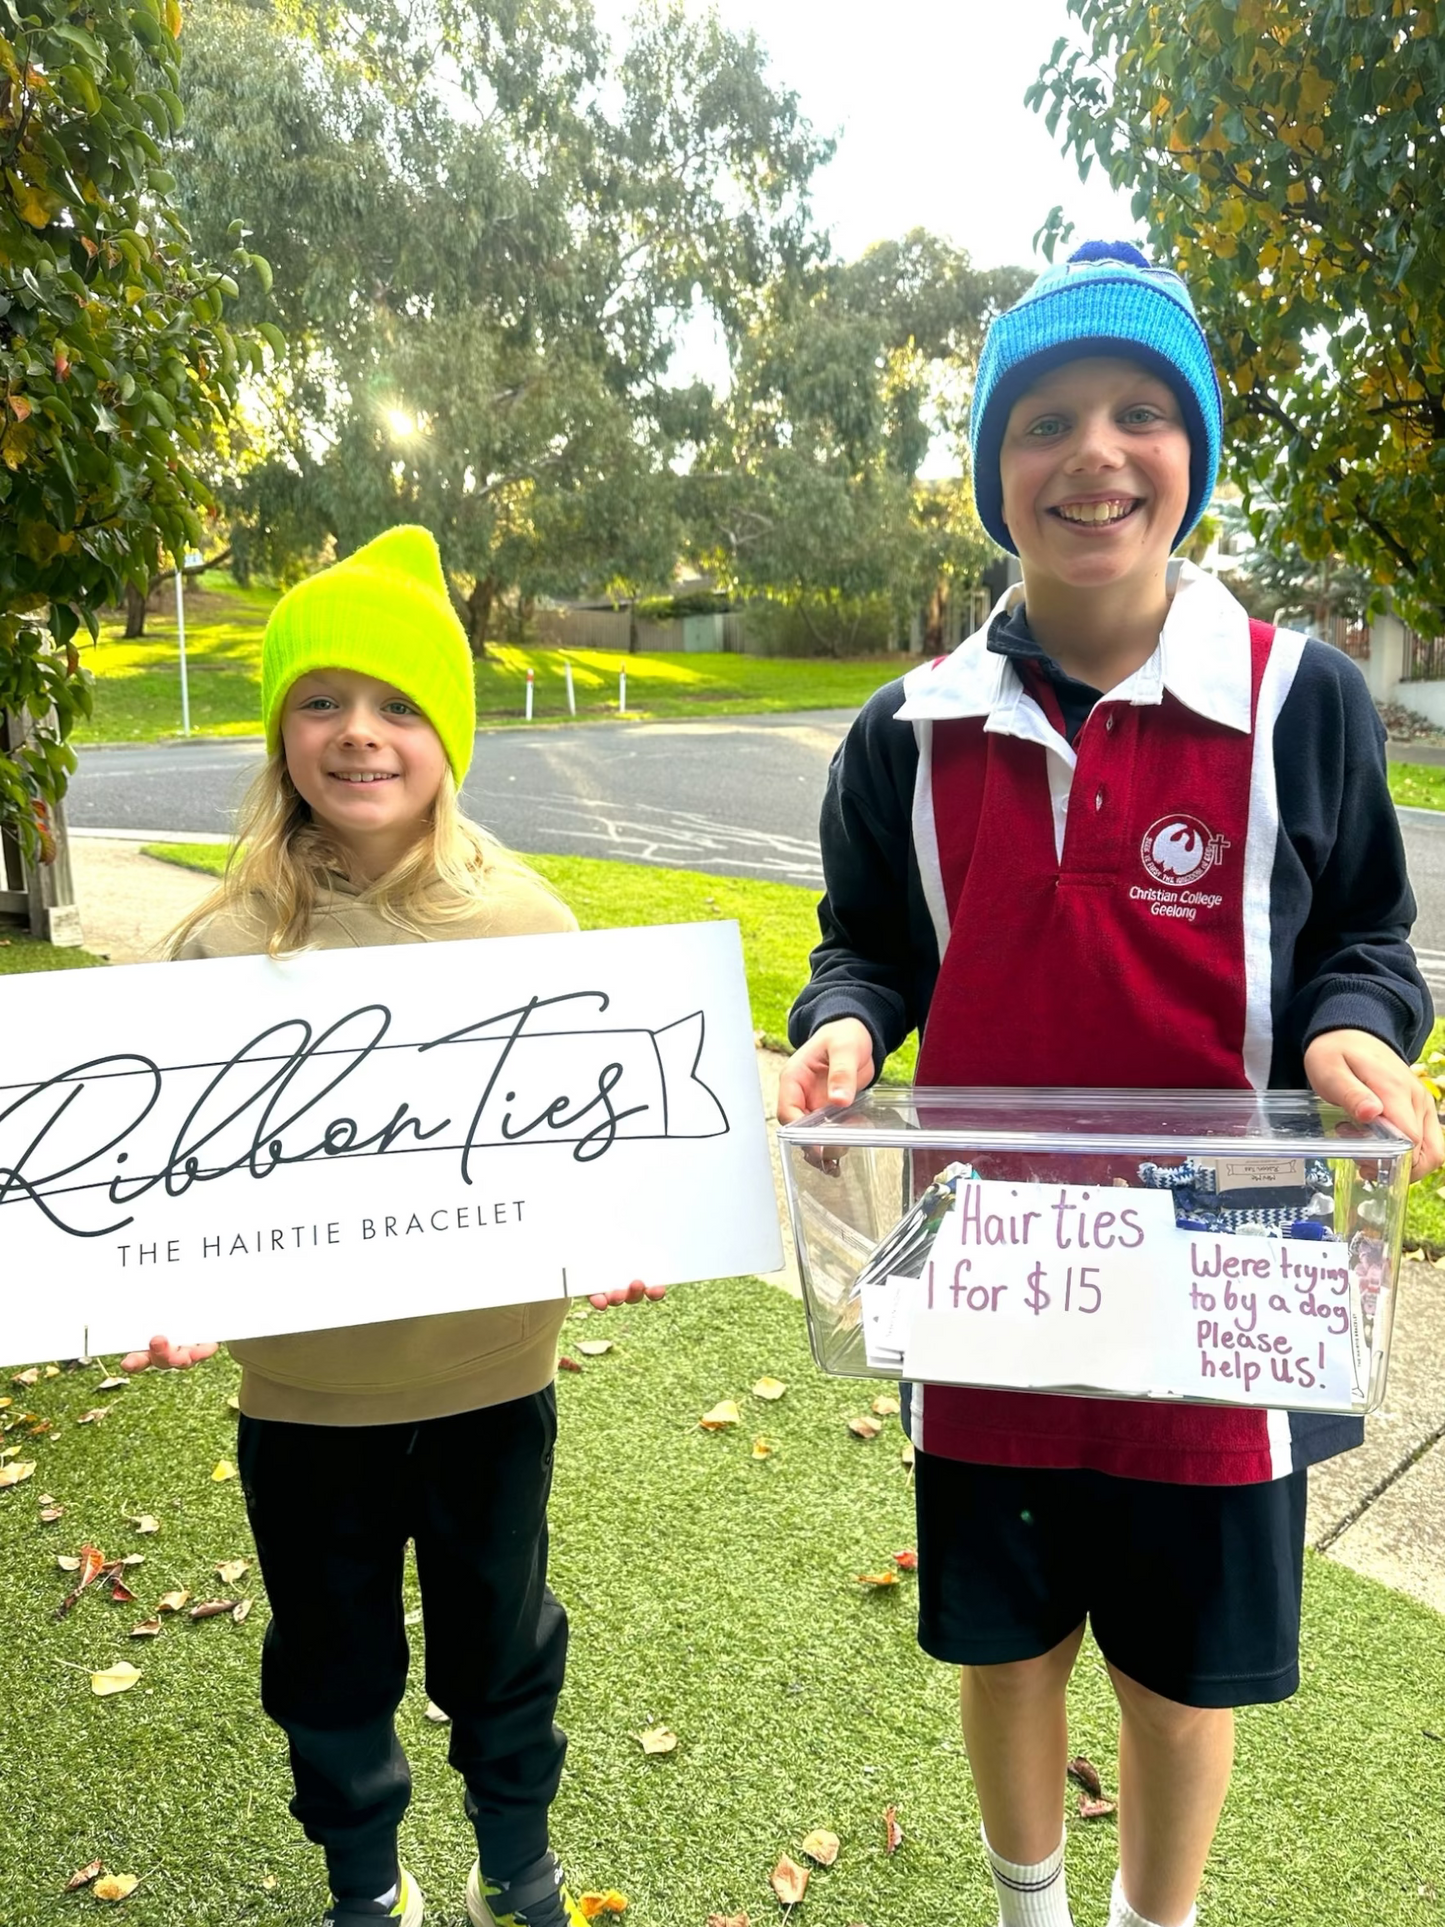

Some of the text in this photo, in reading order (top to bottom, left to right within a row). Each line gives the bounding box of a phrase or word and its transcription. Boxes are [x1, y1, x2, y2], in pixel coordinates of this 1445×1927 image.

[1129, 886, 1222, 908] Christian College
[1151, 902, 1197, 921] Geelong
[0, 991, 649, 1237] Ribbon Ties
[117, 1200, 528, 1268] THE HAIRTIE BRACELET
[961, 1184, 1145, 1250] Hair ties
[949, 1258, 1008, 1313] for
[1024, 1261, 1102, 1315] $15
[1189, 1277, 1350, 1335] to by a dog
[1190, 1242, 1349, 1315] Were trying
[1197, 1319, 1293, 1355] Please
[1200, 1342, 1326, 1391] help us!
